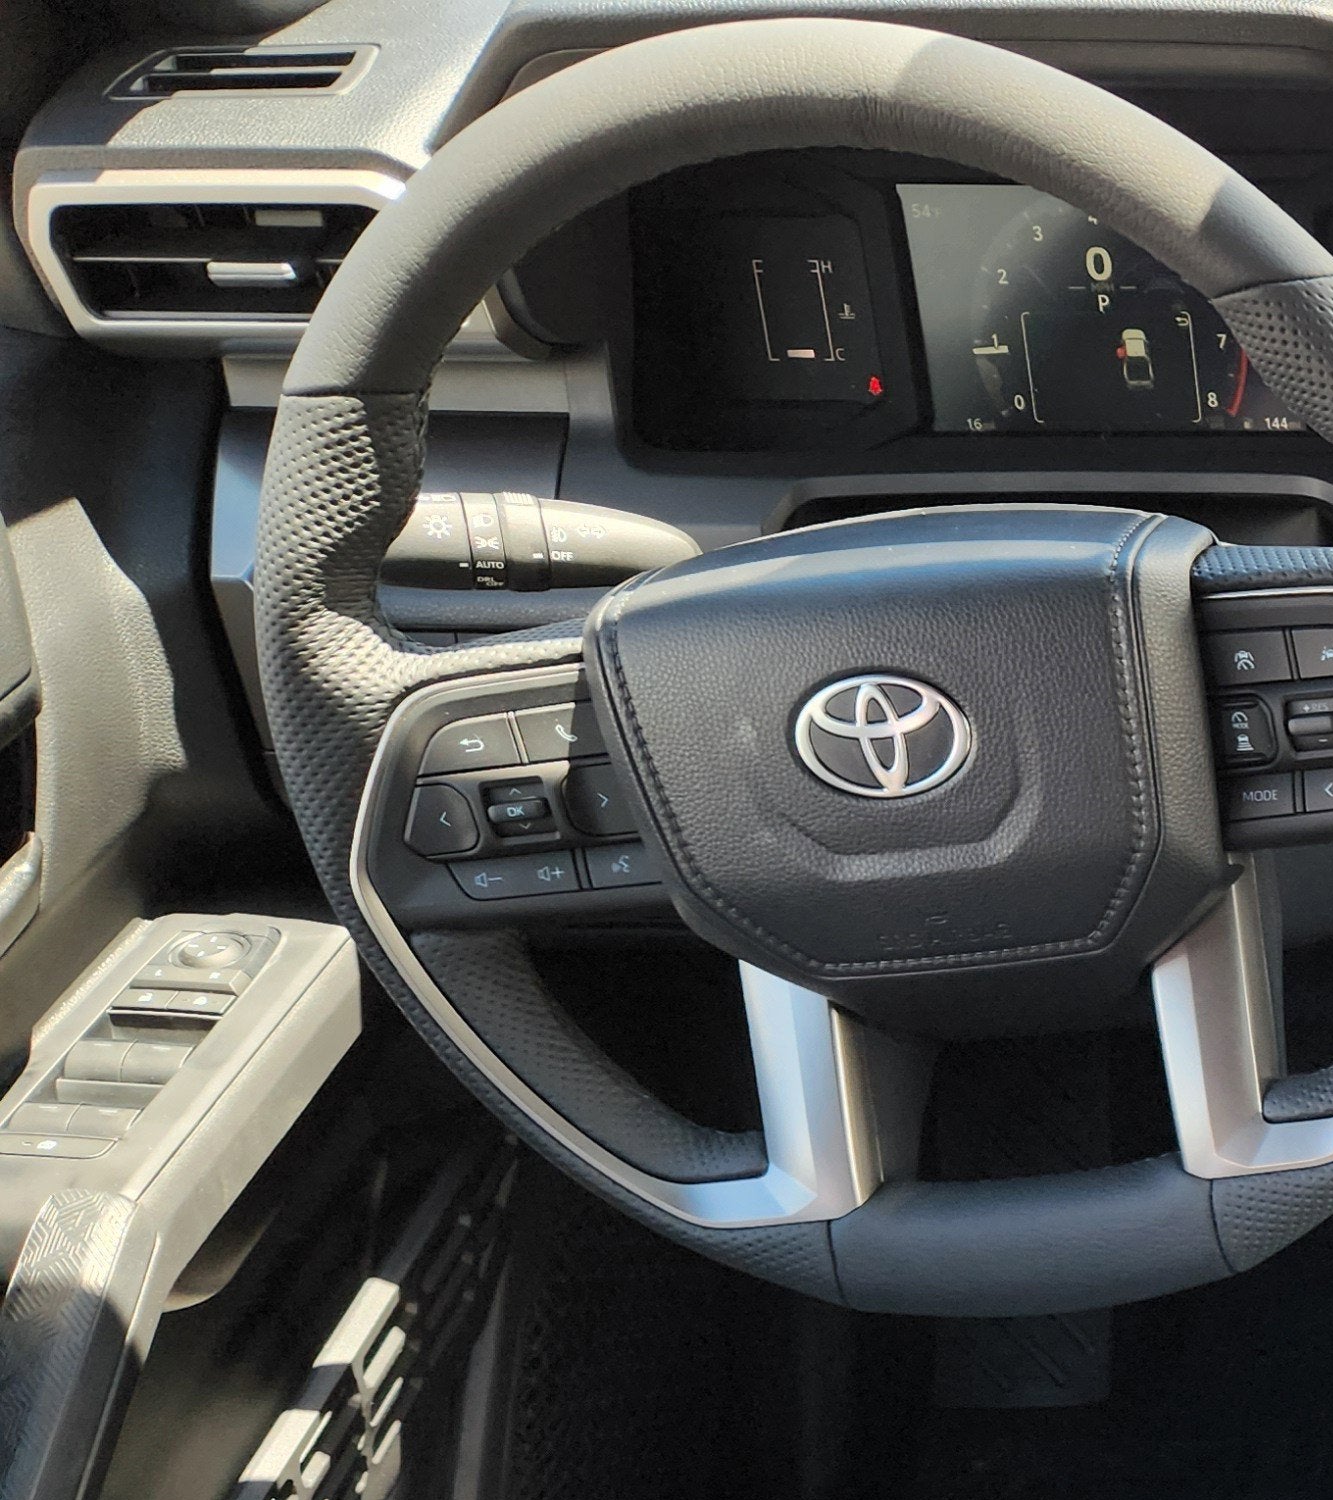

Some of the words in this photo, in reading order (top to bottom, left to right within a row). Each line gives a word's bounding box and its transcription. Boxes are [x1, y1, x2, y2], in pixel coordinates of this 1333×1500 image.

[1032, 225, 1044, 242] 3
[820, 261, 834, 274] H
[1085, 246, 1113, 281] 0
[997, 269, 1009, 285] 2
[1098, 294, 1110, 314] P
[990, 333, 999, 349] 1
[1217, 333, 1227, 349] 7
[835, 348, 845, 361] C
[1014, 394, 1025, 410] 0
[1207, 391, 1219, 408] 8
[1264, 417, 1288, 430] 144
[476, 561, 504, 569] AUTO
[1242, 789, 1278, 801] MODE
[506, 806, 525, 817] OK
